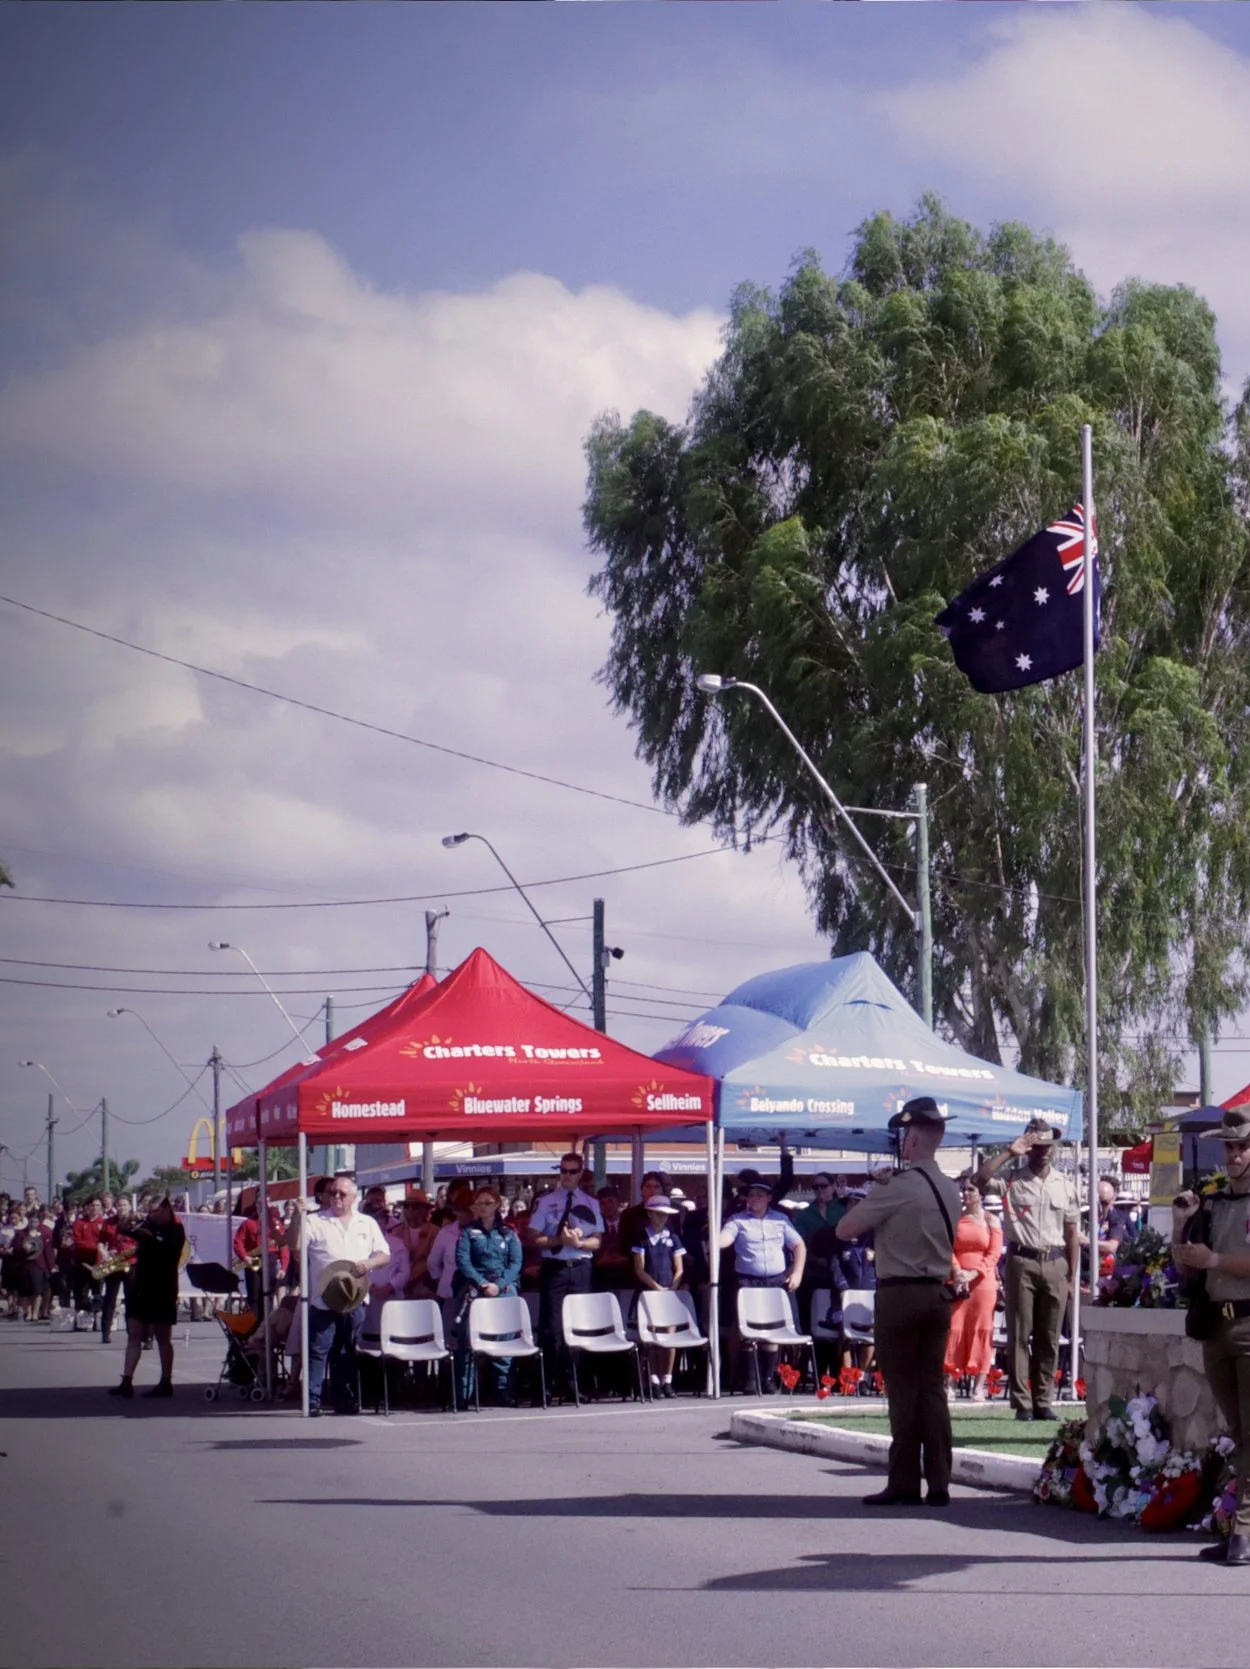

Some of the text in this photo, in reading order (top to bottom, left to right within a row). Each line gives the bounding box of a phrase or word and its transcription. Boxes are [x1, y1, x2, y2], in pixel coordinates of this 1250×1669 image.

[423, 1044, 601, 1060] Charters Towers
[809, 1052, 906, 1070] Charters
[910, 1060, 994, 1080] Towers
[331, 1099, 405, 1118] Homestead
[464, 1095, 582, 1116] Bluewater Springs
[646, 1094, 702, 1111] Sellheim
[750, 1096, 855, 1117] Belyando Crossing
[992, 1105, 1069, 1126] Hidden Valley
[456, 1163, 492, 1173] Vinnies
[672, 1162, 706, 1172] Vinnies
